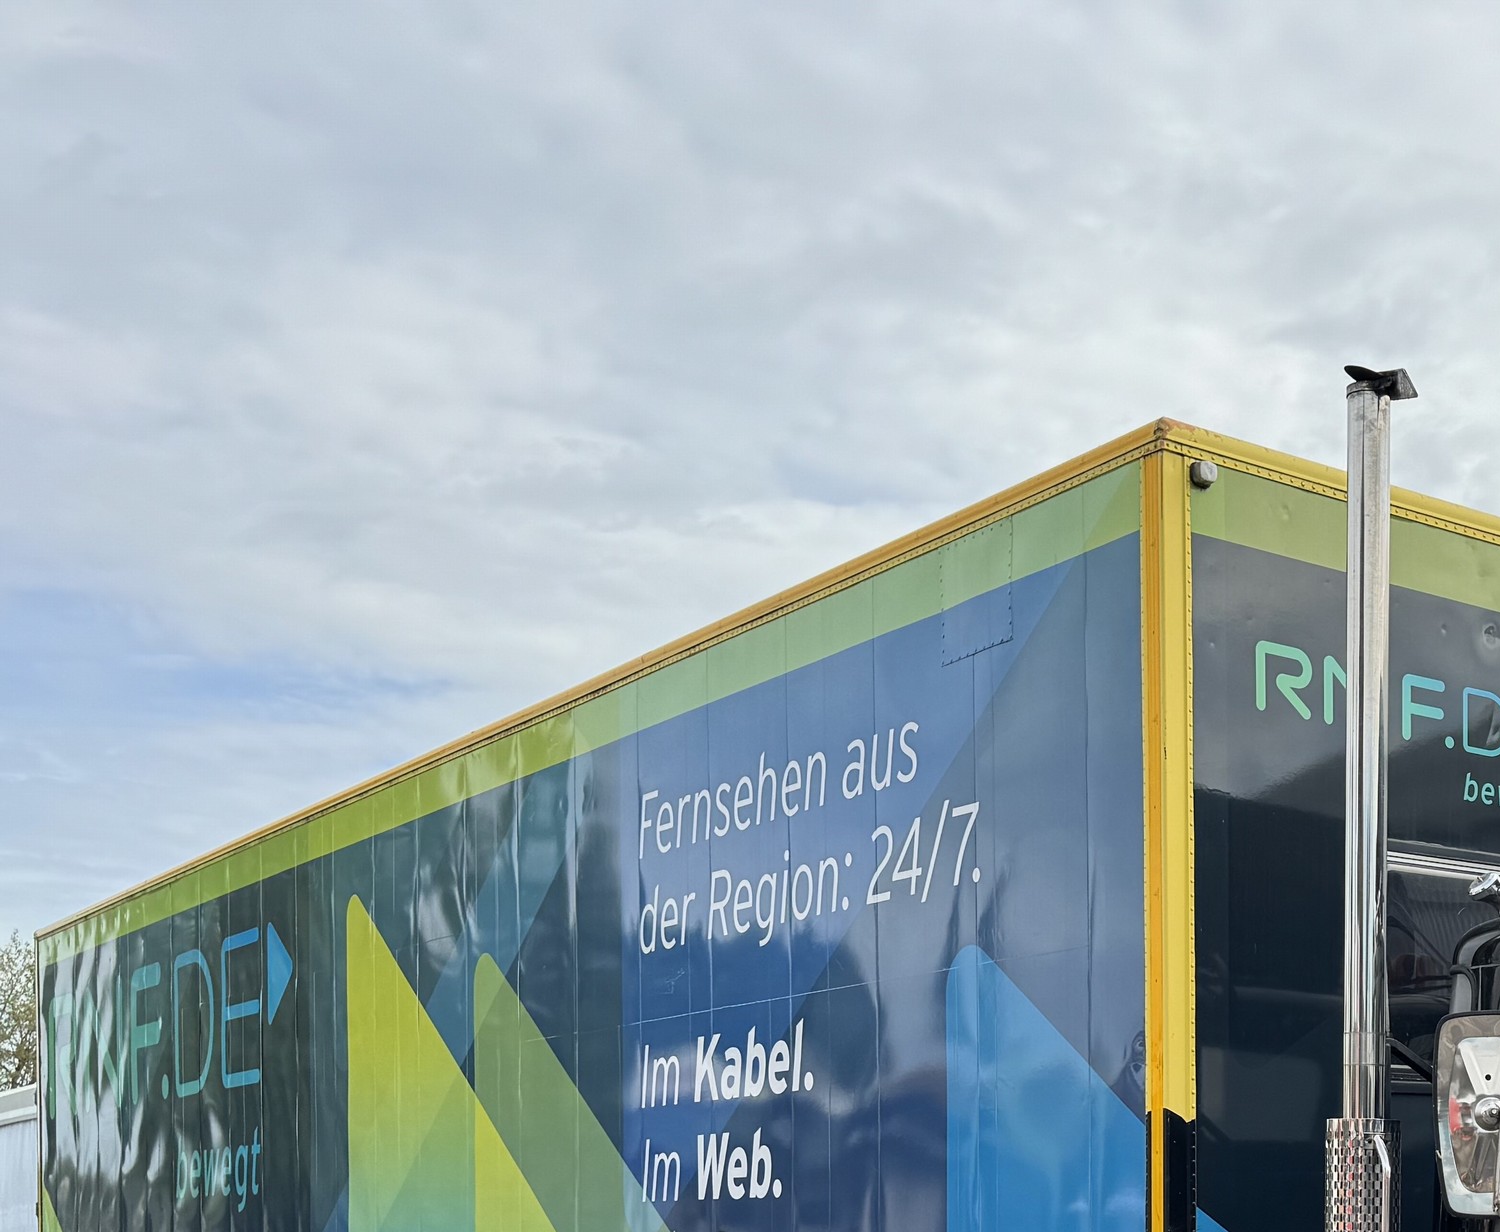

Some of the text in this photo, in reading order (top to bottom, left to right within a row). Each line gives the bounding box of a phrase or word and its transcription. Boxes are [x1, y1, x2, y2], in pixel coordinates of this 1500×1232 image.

[639, 721, 920, 859] Fernsehen aus
[639, 799, 982, 955] der Region: 24/7.
[48, 926, 261, 1119] RNF.DE
[640, 1019, 814, 1108] Im Kabel.
[176, 1127, 261, 1212] bewegt
[642, 1127, 783, 1202] Im Web.
